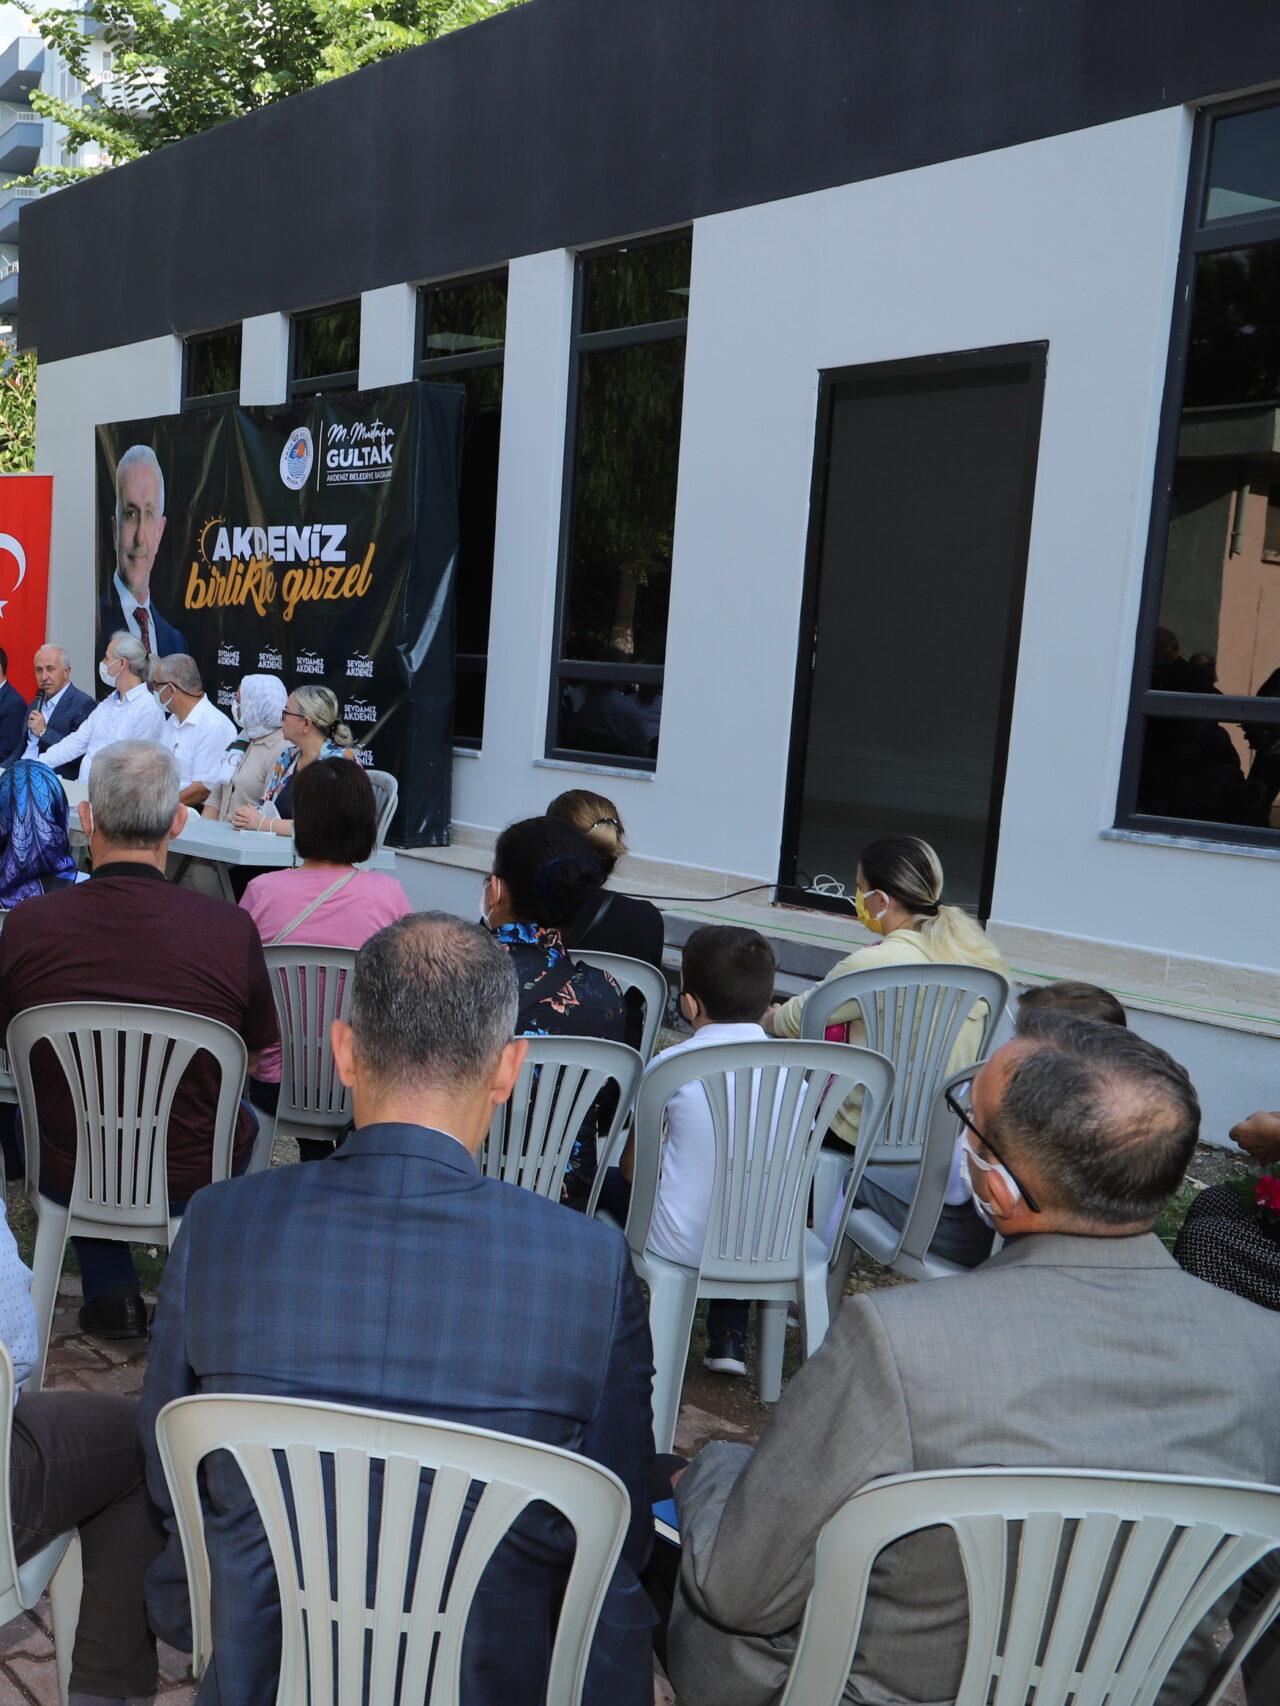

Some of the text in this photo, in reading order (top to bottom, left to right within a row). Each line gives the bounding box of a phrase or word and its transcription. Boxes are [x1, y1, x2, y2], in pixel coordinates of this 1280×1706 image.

[328, 423, 349, 446] M.
[185, 542, 376, 622] birlikte güzel
[343, 704, 377, 713] SEVDAMIZ
